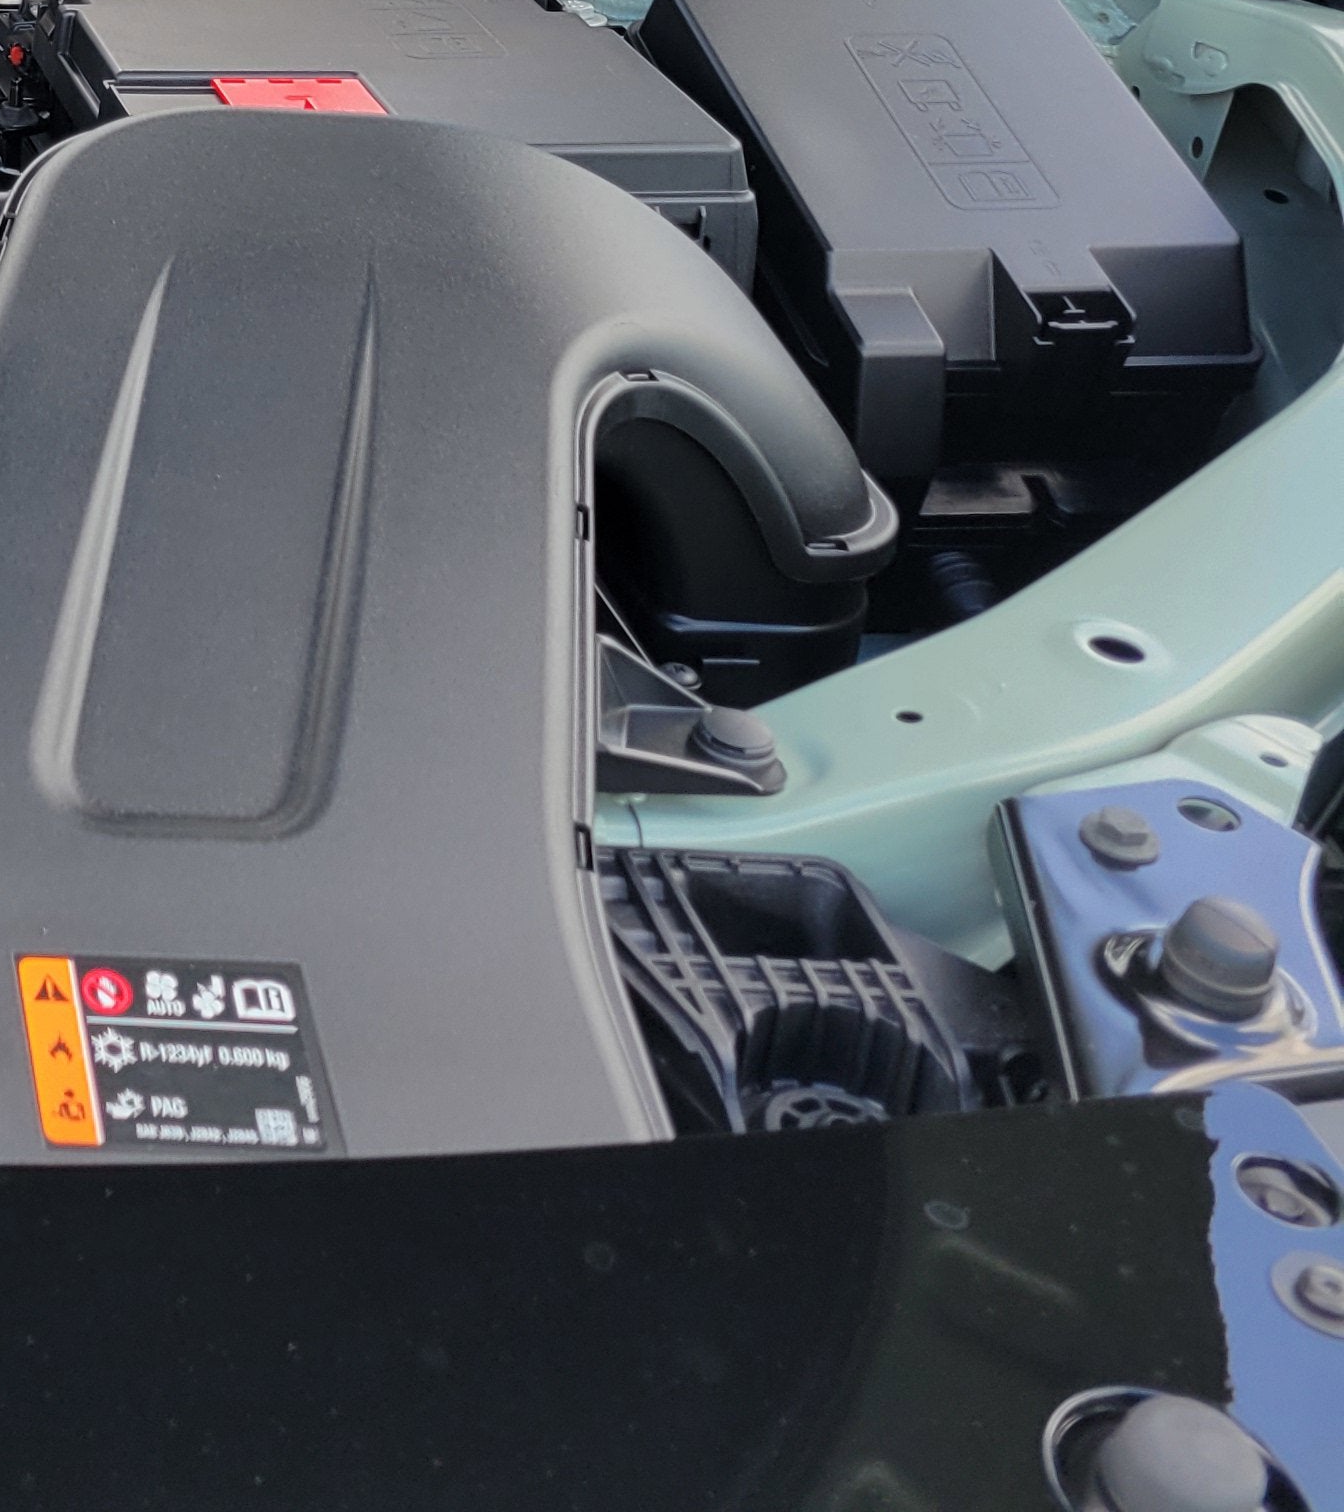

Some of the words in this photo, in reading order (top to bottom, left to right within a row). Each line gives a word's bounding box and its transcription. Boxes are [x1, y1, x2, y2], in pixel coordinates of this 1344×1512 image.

[147, 999, 186, 1016] AUTO
[265, 1047, 291, 1072] kg
[150, 1094, 188, 1119] PAG
